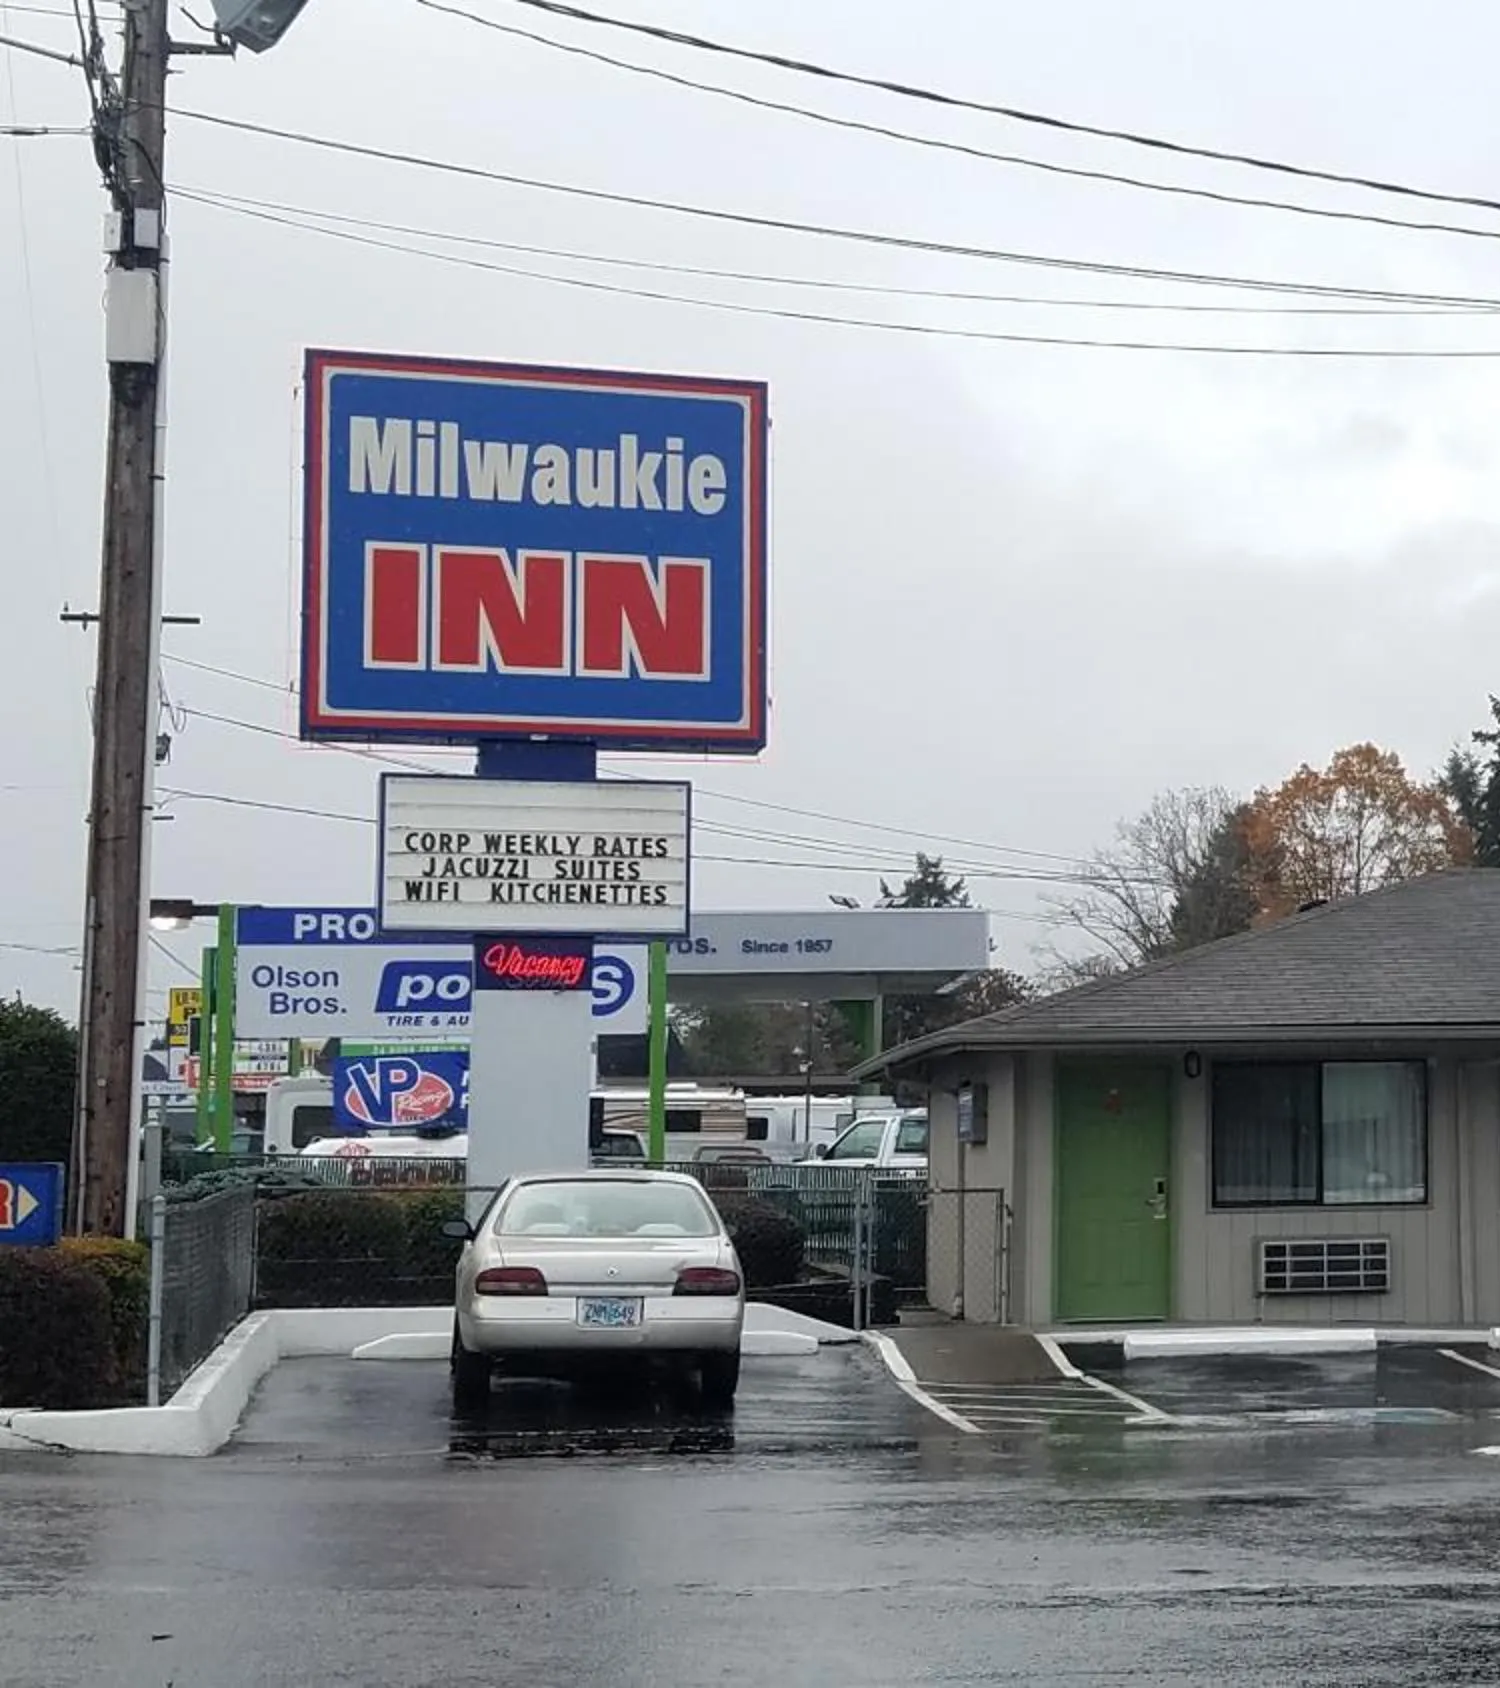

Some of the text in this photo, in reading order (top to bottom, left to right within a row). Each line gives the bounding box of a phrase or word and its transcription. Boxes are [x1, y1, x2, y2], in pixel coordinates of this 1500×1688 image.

[348, 415, 727, 515] Milwaukie
[363, 540, 711, 682] INN
[404, 832, 669, 857] CORP WEEKLY RATES
[422, 857, 641, 880] JACUZZI SUITES
[404, 881, 668, 905] WIFI KITCHENETTES
[741, 939, 789, 954] Since
[795, 939, 833, 953] 1957
[251, 965, 339, 987] Olson
[483, 943, 586, 985] Vacancy
[269, 992, 348, 1014] Bros.
[387, 1016, 424, 1026] TIRE
[447, 1016, 469, 1026] AU
[346, 1057, 421, 1125] VP
